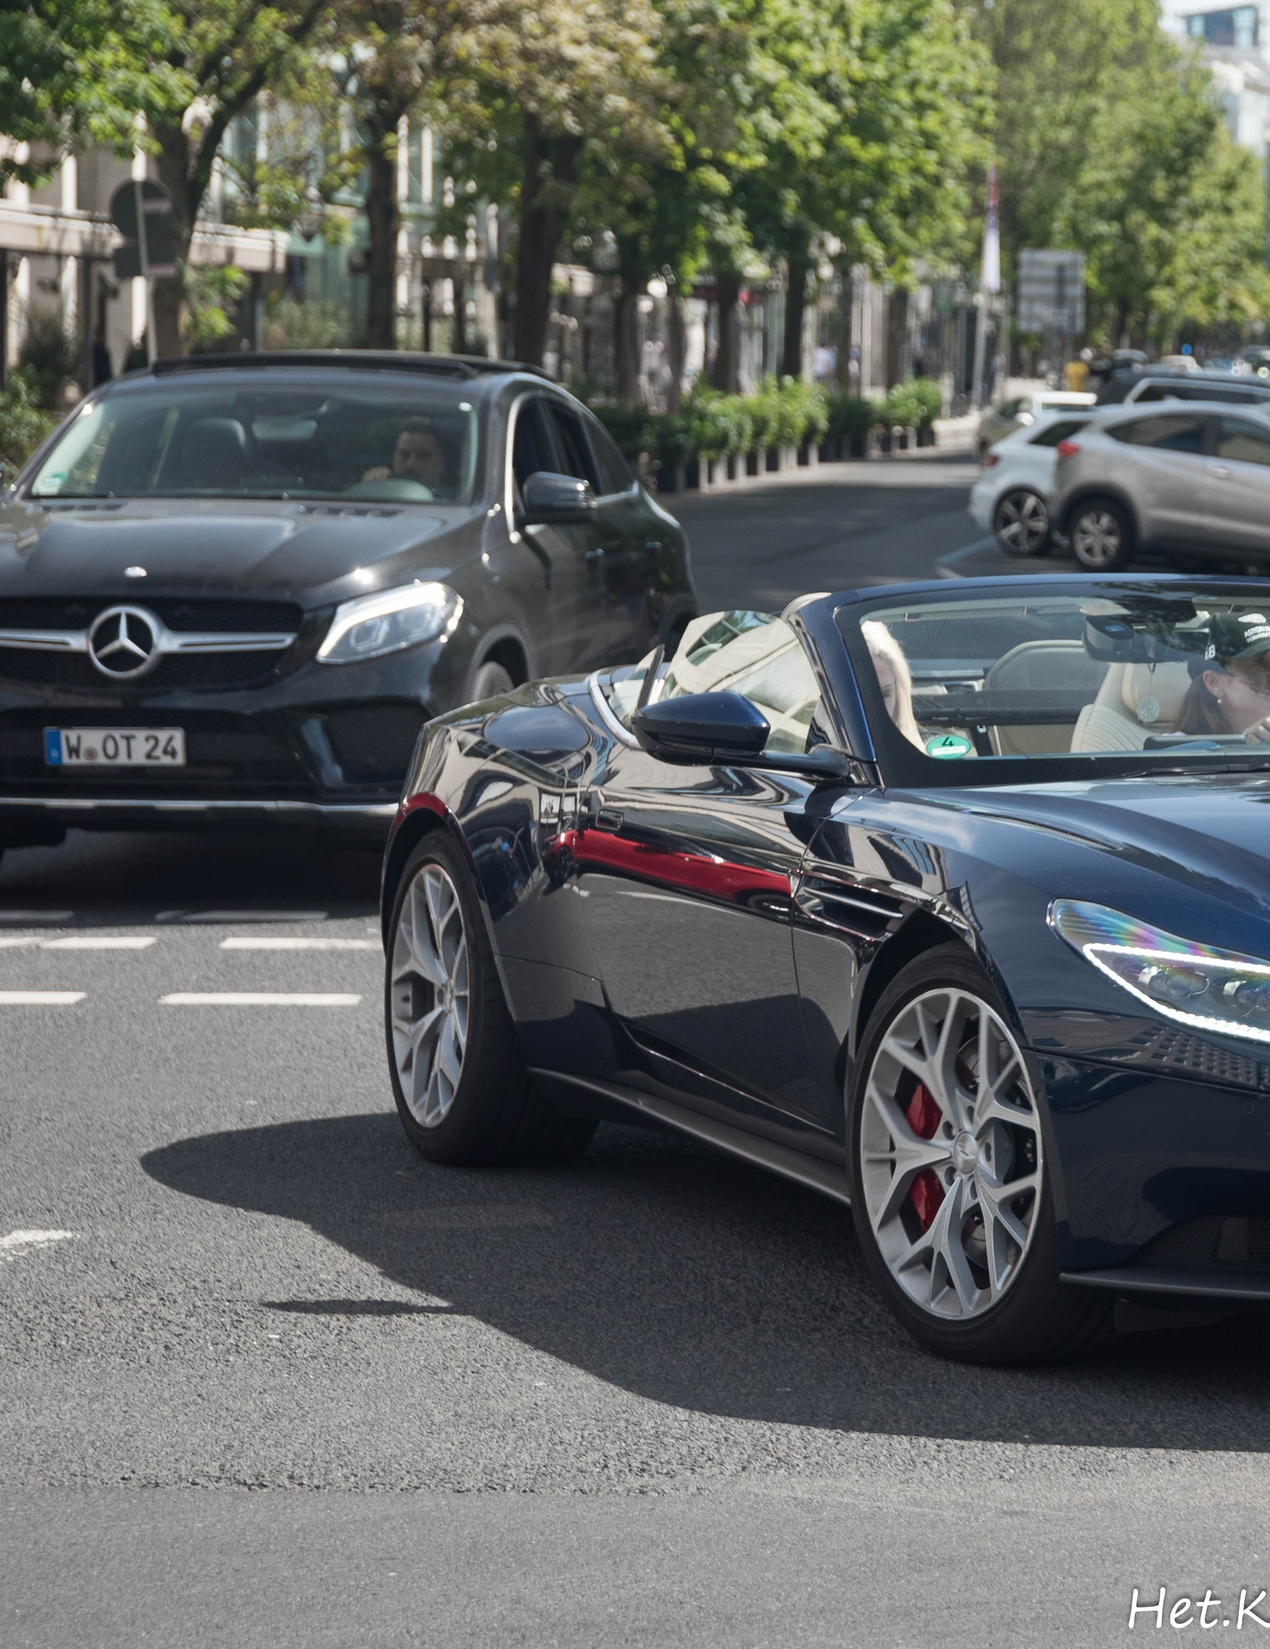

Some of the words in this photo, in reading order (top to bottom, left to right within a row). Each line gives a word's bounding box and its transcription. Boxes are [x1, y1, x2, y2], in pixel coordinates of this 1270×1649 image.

[1204, 644, 1216, 660] 18
[64, 733, 82, 760] W
[102, 733, 136, 760] OT
[144, 734, 178, 761] 24
[942, 736, 954, 746] 4
